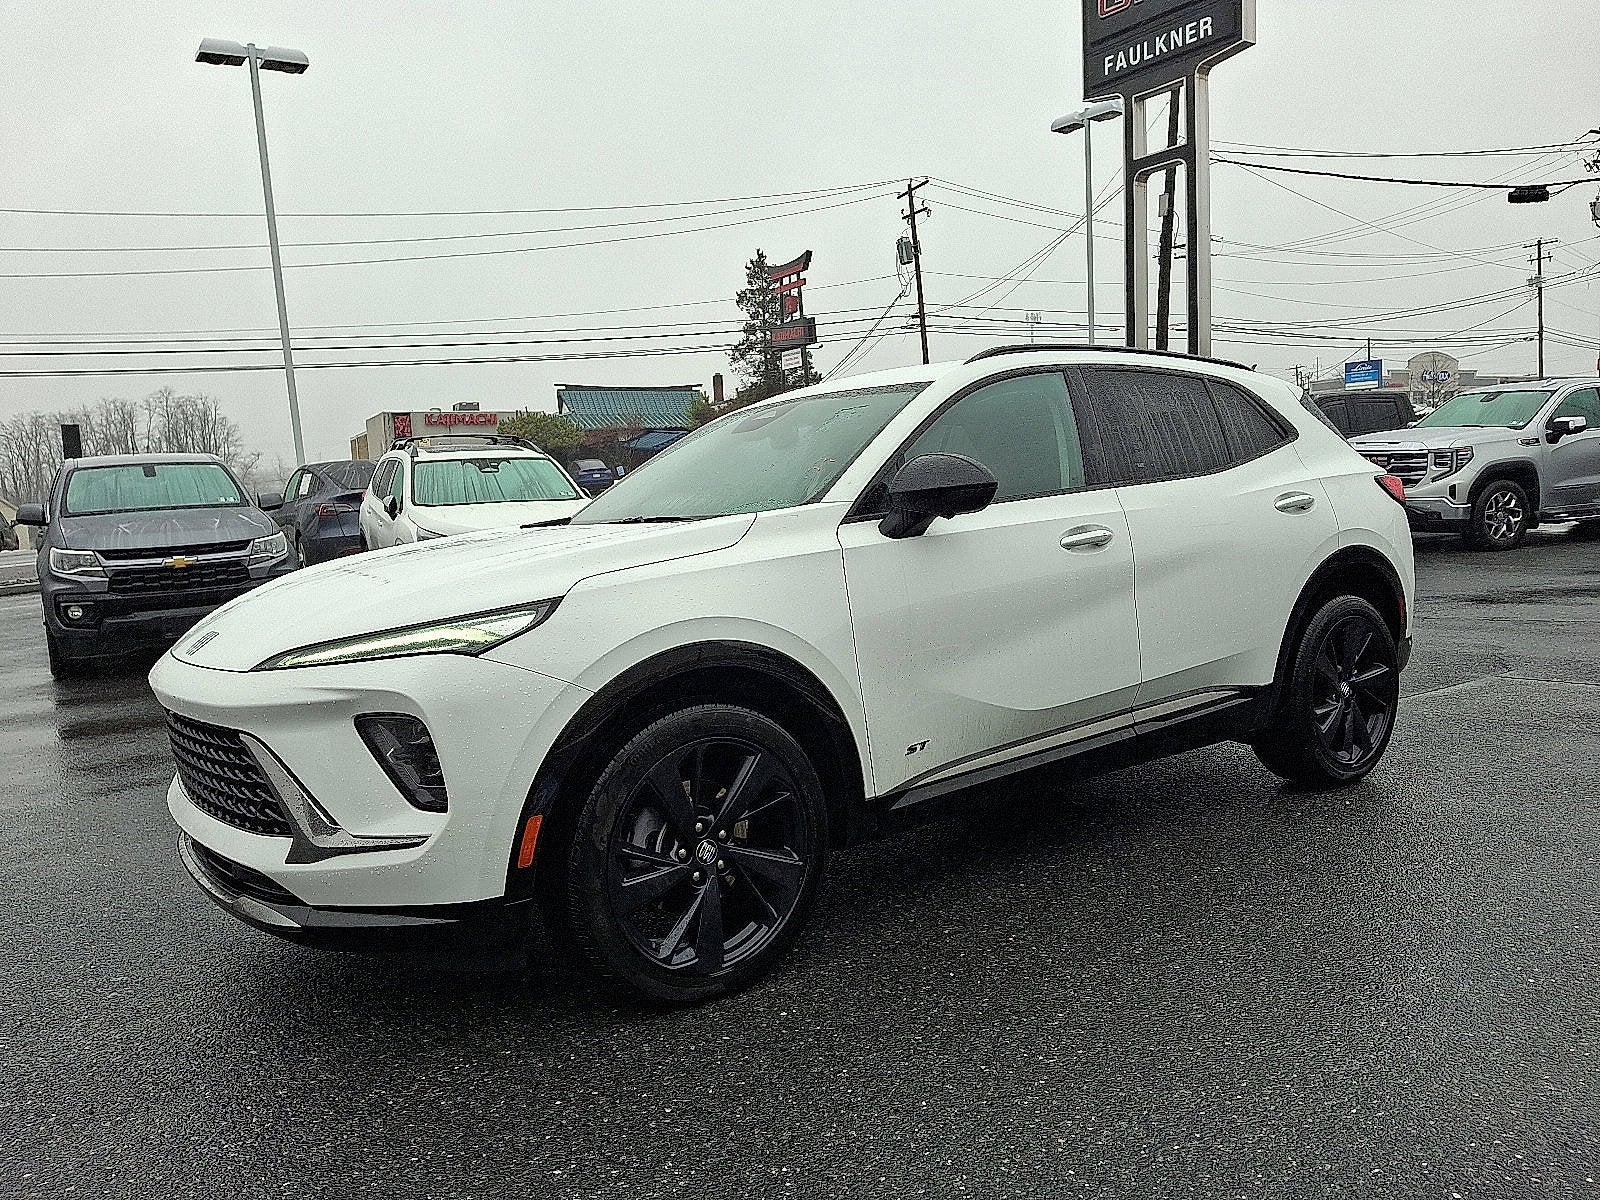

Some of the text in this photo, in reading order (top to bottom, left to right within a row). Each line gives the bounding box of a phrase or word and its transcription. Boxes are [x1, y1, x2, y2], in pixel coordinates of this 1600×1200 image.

[1104, 16, 1213, 76] FAULKNER
[424, 413, 497, 428] KAJIMACHI
[905, 739, 931, 756] ST
